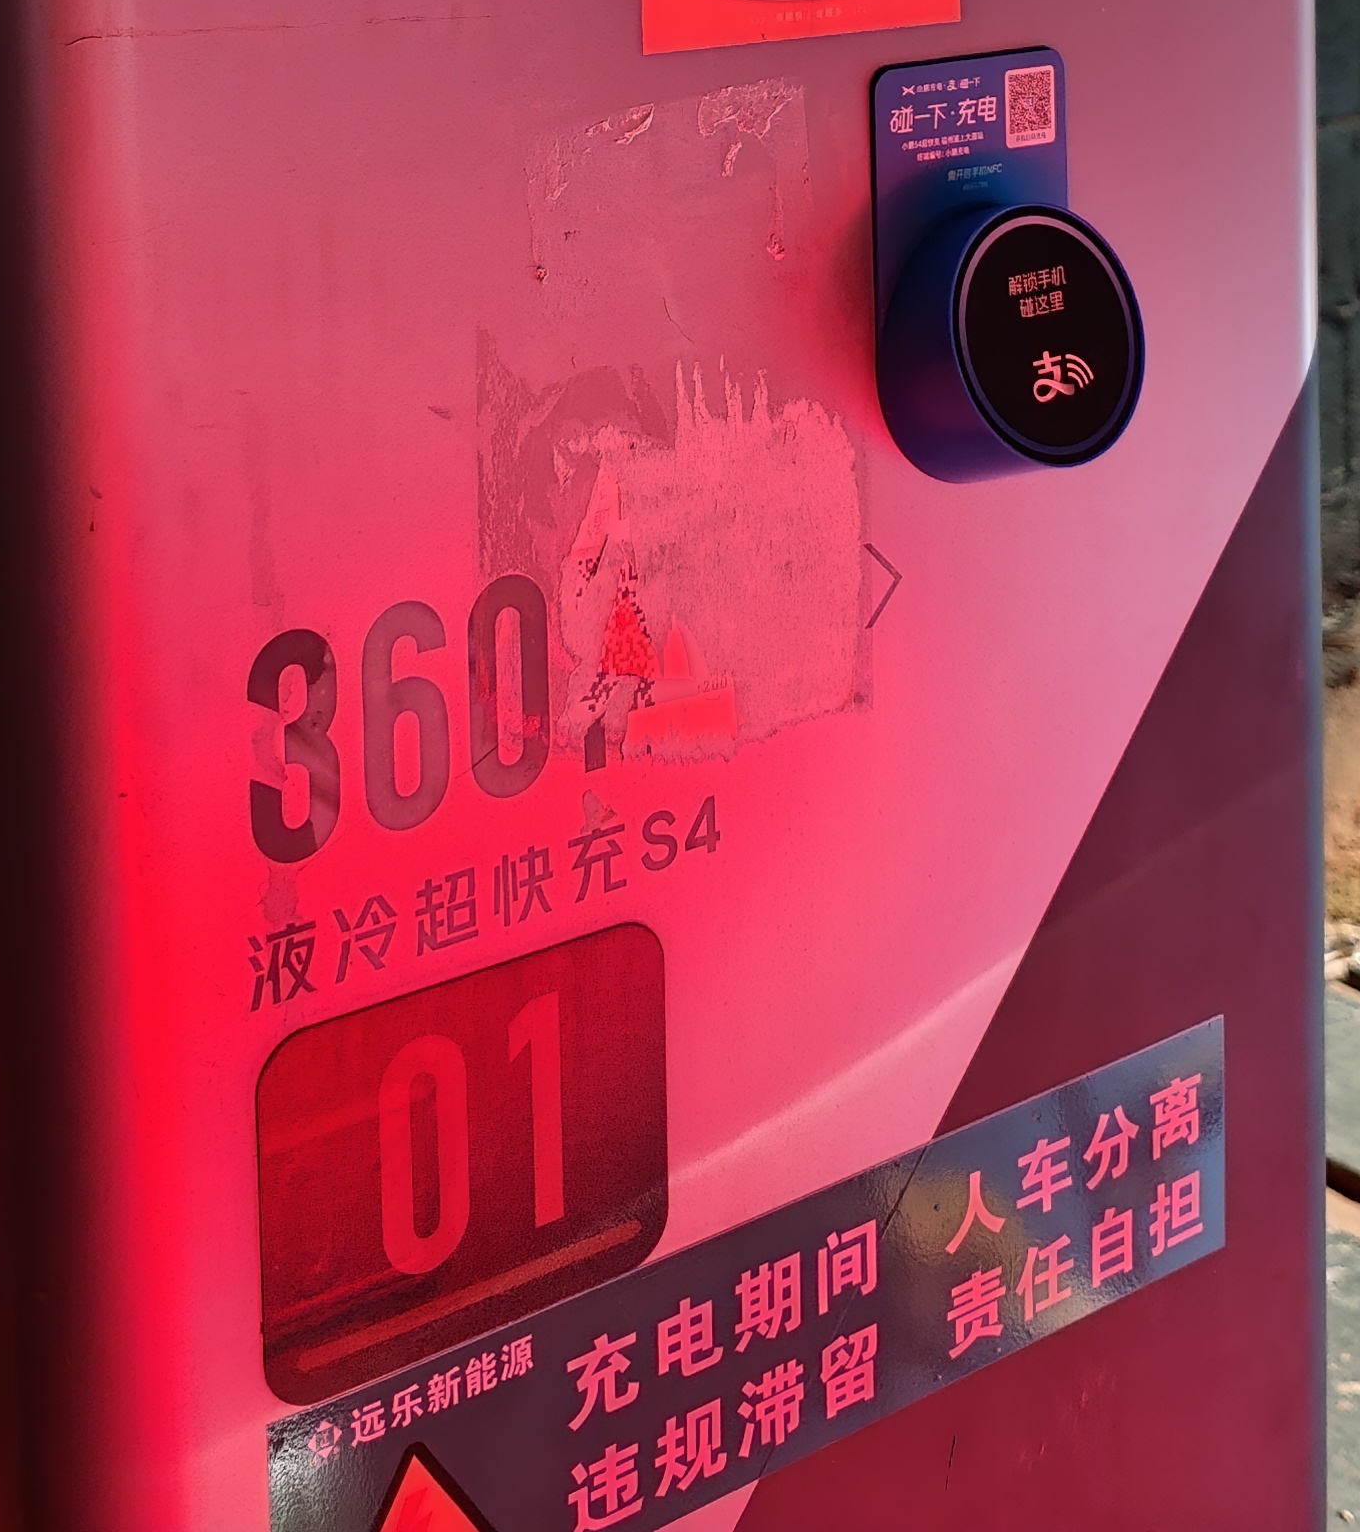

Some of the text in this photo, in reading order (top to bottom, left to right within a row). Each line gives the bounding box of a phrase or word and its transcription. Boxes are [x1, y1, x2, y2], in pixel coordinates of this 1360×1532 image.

[890, 95, 998, 134] 碰一下·充电
[1008, 265, 1067, 296] 解锁手机
[1019, 291, 1065, 318] 碰这里
[248, 795, 721, 1012] 液冷超快充S4
[377, 990, 564, 1276] 01
[566, 1073, 1203, 1432] 充电期间 人车分离
[351, 1334, 534, 1448] 远乐新能源
[567, 1170, 1204, 1532] 违规滞留 责任自担
